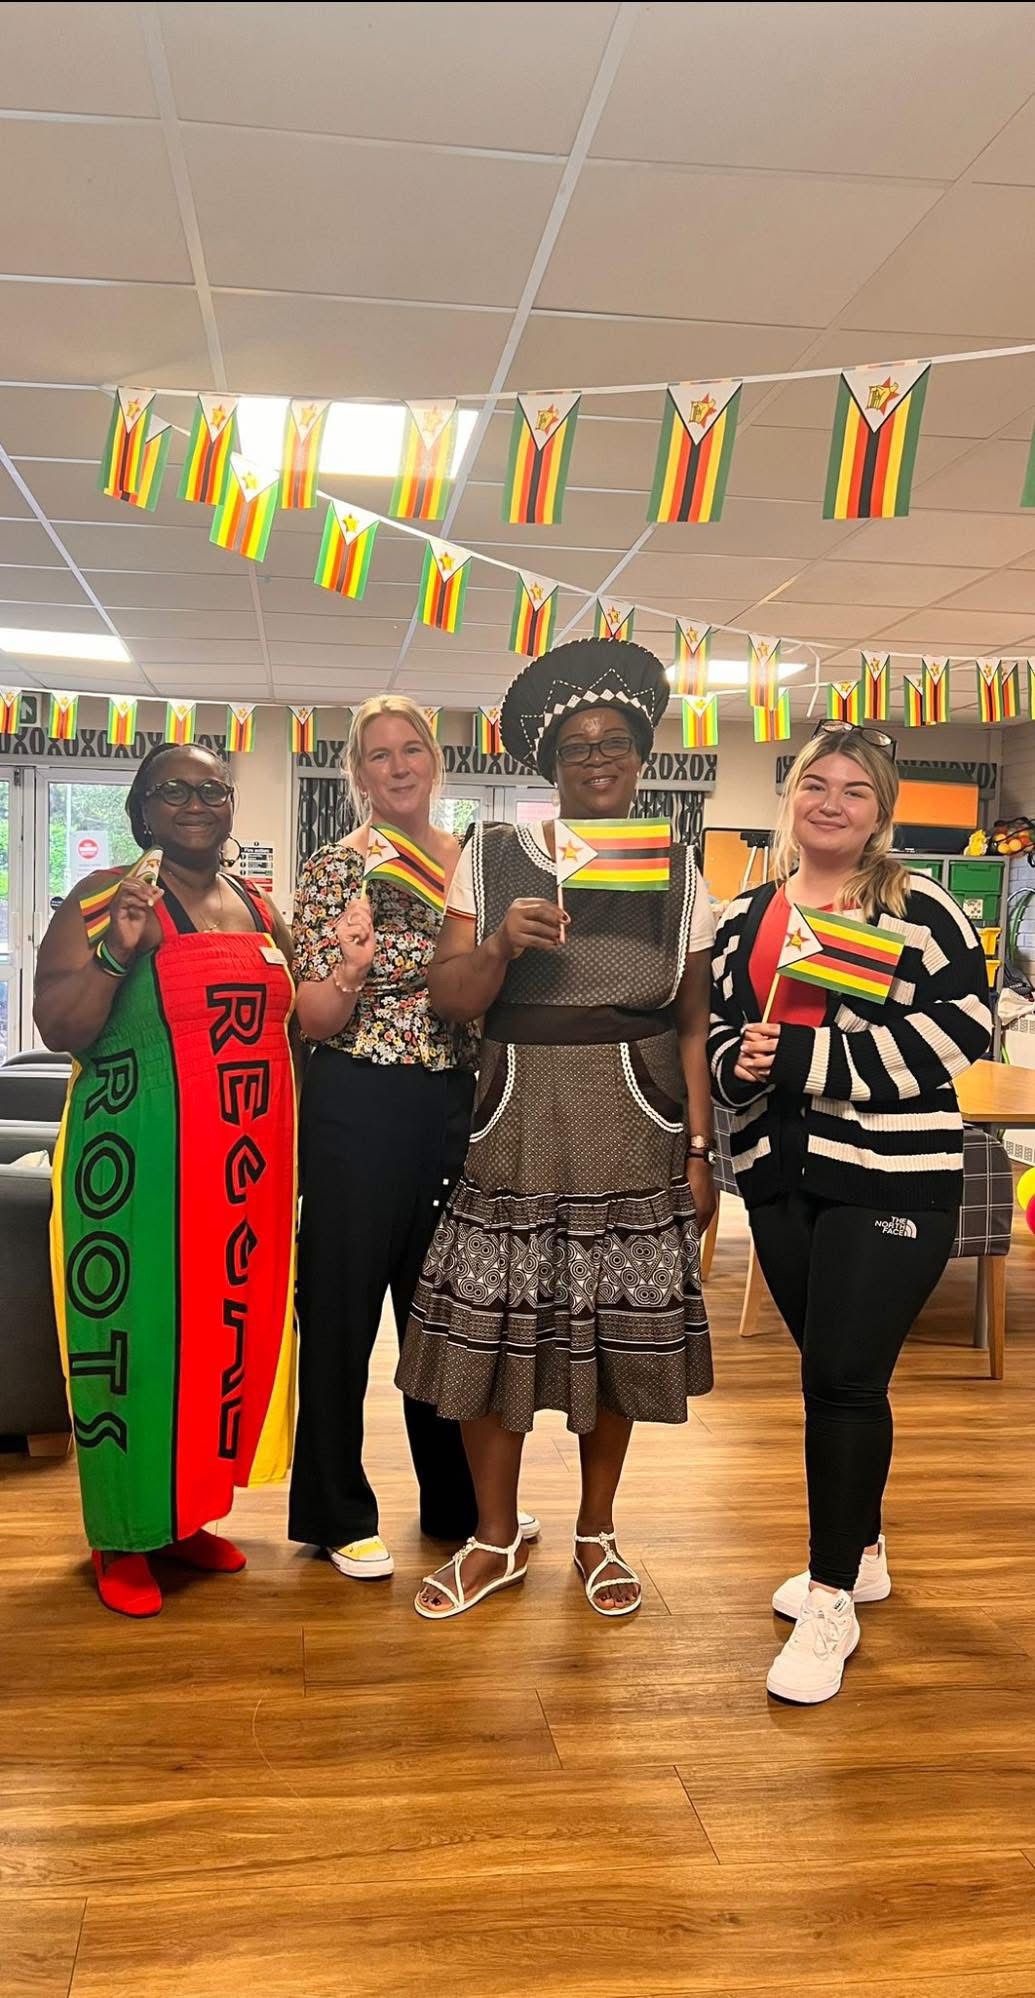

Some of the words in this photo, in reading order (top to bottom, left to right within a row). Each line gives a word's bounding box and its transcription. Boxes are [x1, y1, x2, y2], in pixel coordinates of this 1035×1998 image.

[891, 1216, 906, 1224] THE
[874, 1220, 906, 1231] NORTH
[882, 1227, 904, 1236] FACE
[66, 1047, 139, 1455] ROOTS
